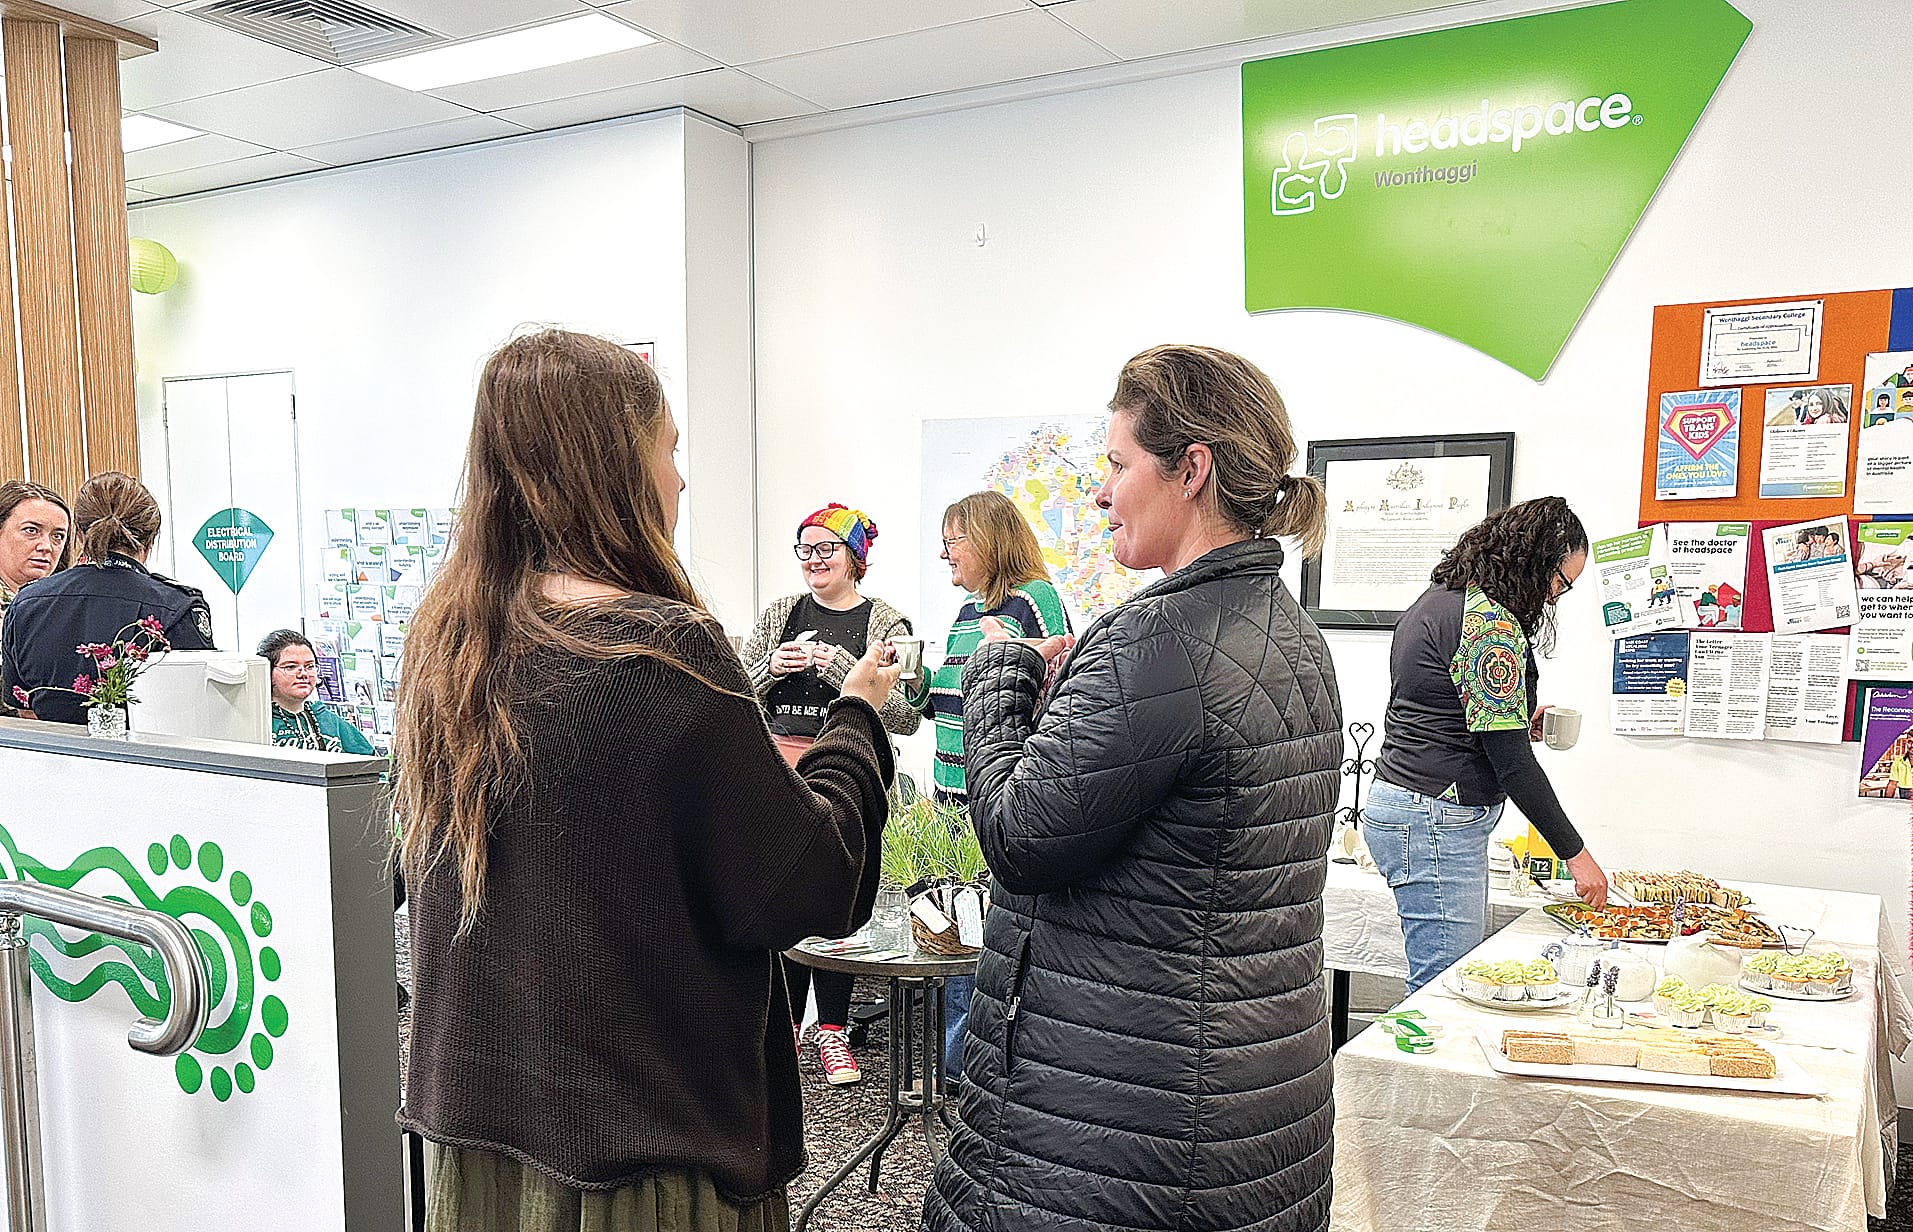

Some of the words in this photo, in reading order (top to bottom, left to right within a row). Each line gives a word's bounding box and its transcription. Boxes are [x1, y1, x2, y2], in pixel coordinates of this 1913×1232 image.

[1374, 160, 1478, 189] Wonthaggi
[1751, 313, 1782, 321] Secondary
[1783, 312, 1806, 320] College
[1682, 416, 1717, 425] SUPPORT
[1684, 423, 1715, 432] TRANS
[1689, 431, 1710, 440] KIDS
[1676, 464, 1704, 472] AFFIRM
[1705, 463, 1719, 471] THE
[1687, 471, 1706, 479] YOU
[1706, 469, 1728, 479] LOVE
[207, 526, 254, 538] ELECTRICAL
[205, 538, 257, 550] DISTRIBUTION
[1683, 546, 1733, 555] headspace
[218, 550, 245, 562] BOARD
[1895, 595, 1913, 604] help
[1860, 603, 1876, 612] get
[1859, 612, 1877, 620] you
[792, 705, 802, 715] BE
[803, 705, 820, 717] ACE
[1534, 860, 1550, 871] T2
